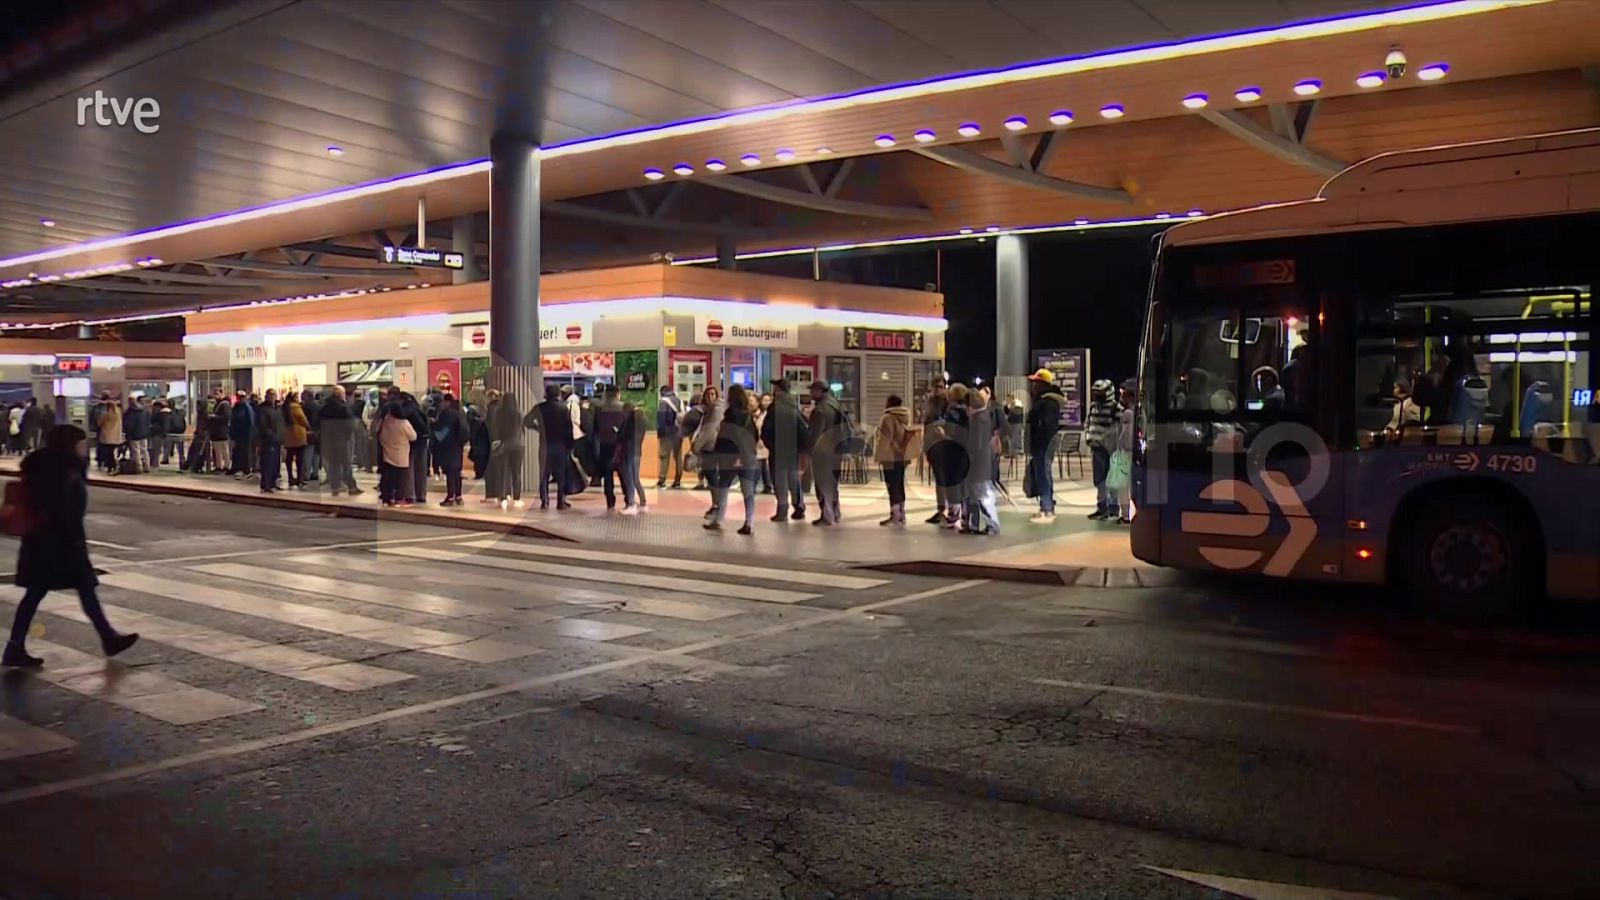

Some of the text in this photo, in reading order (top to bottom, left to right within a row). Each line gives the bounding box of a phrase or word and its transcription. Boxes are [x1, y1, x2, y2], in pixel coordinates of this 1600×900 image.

[731, 326, 788, 340] Busburguer!
[235, 345, 269, 361] summy
[1486, 454, 1537, 472] 4730
